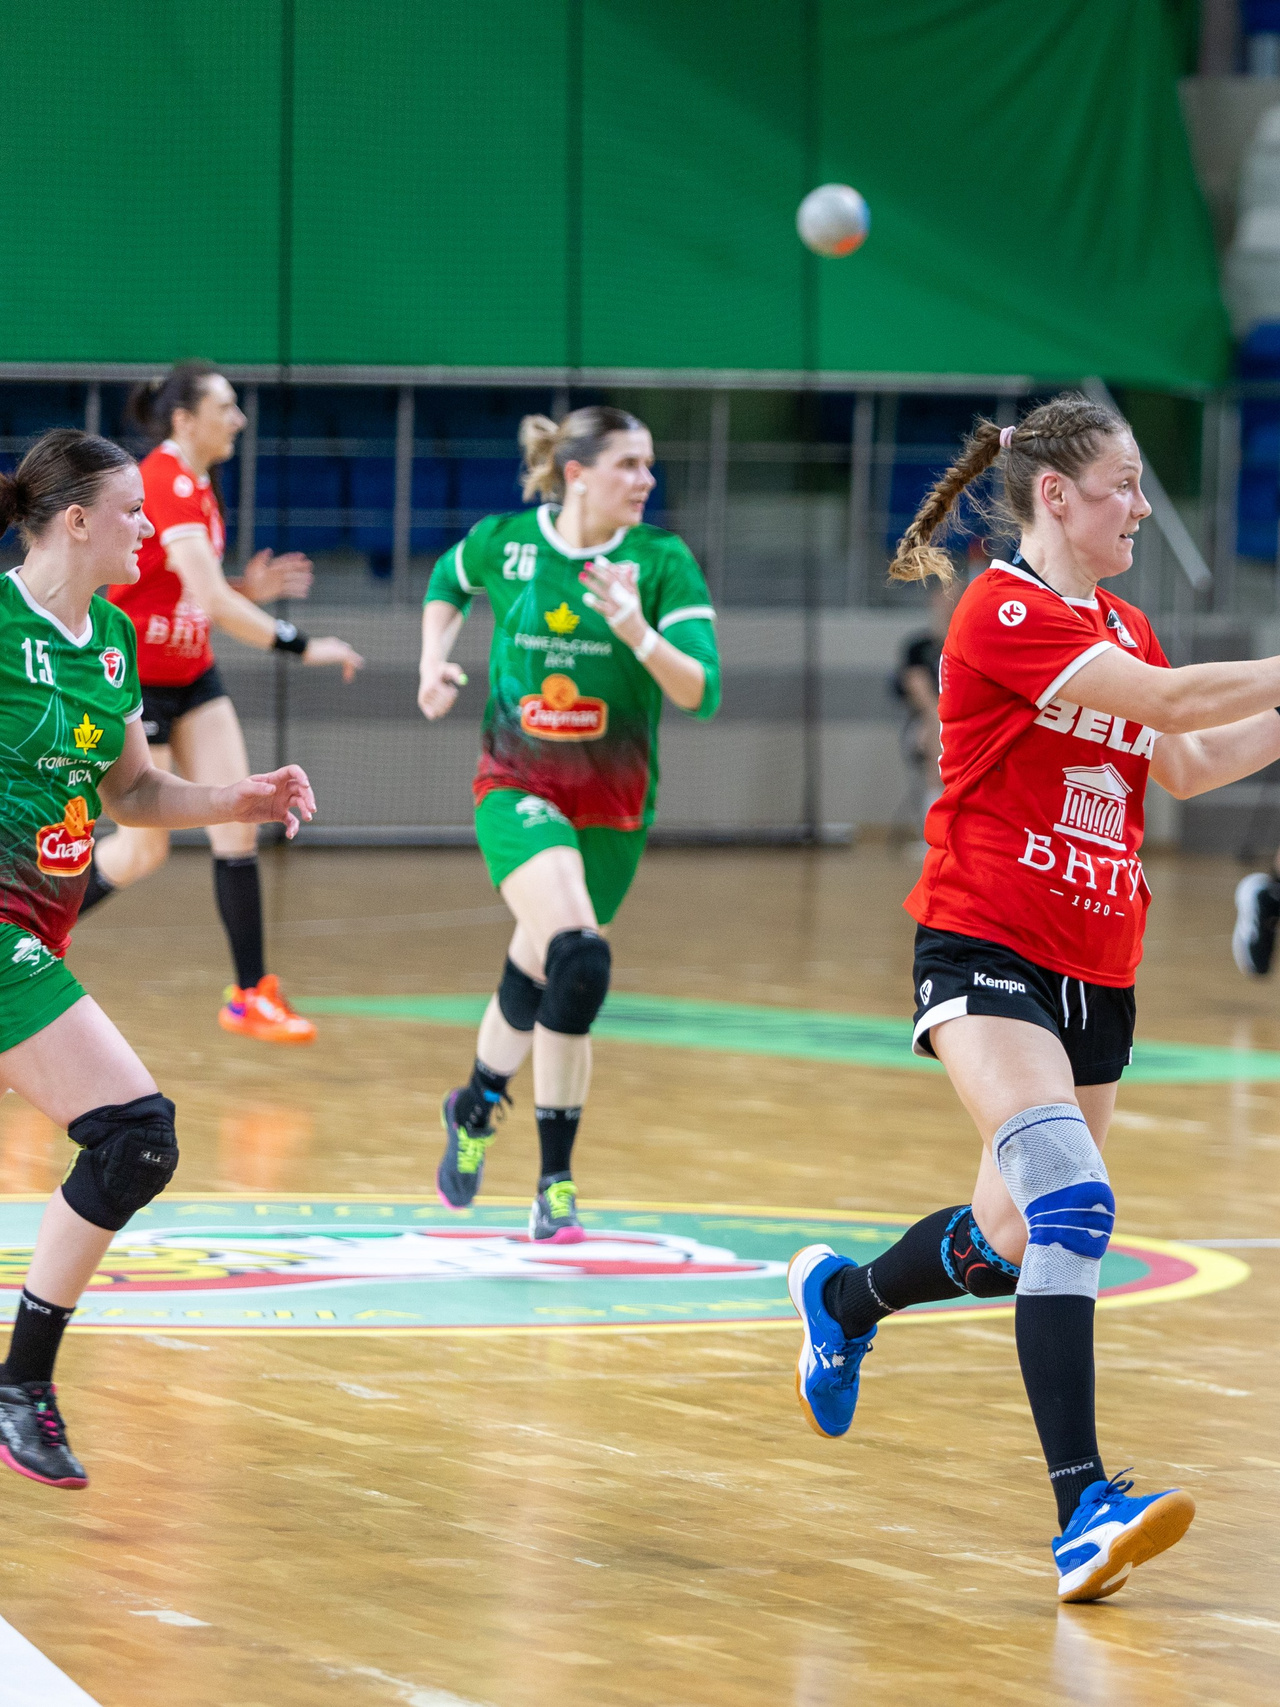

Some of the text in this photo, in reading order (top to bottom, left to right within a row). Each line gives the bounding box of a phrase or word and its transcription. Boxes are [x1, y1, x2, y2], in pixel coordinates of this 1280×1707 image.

[502, 541, 538, 581] 26
[21, 637, 54, 686] 15
[1033, 697, 1164, 761] BELA
[1017, 827, 1142, 901] БНТУ
[1071, 894, 1110, 917] 1920
[973, 971, 1026, 994] Kempa
[1049, 1460, 1095, 1480] empa
